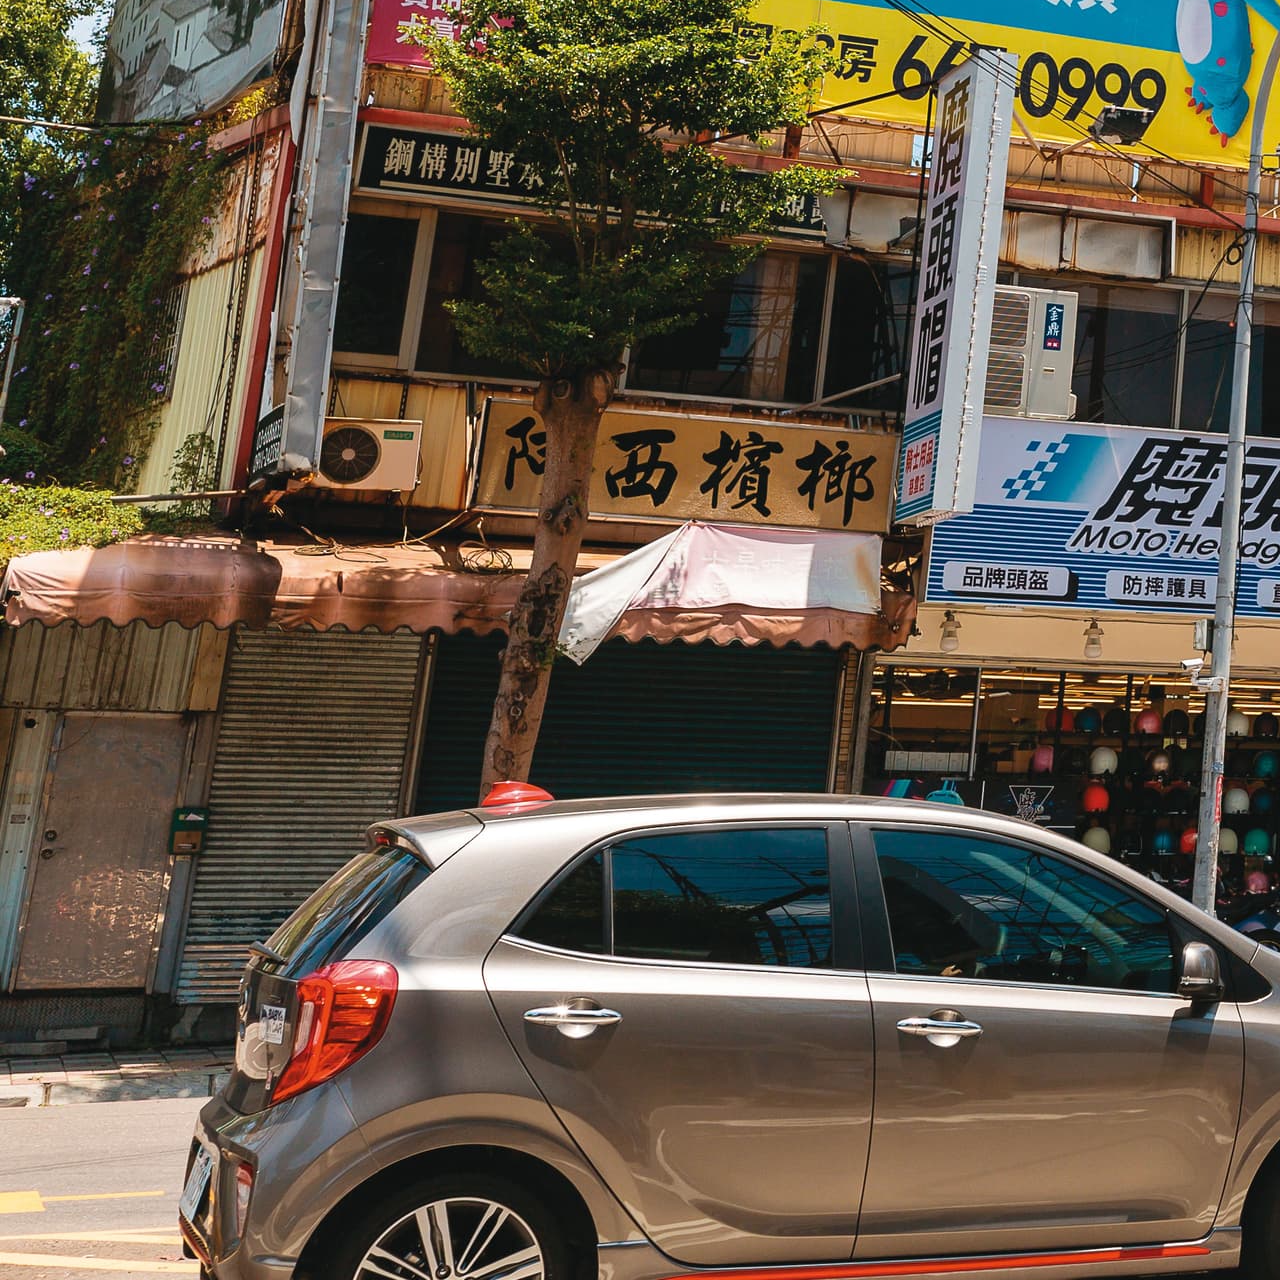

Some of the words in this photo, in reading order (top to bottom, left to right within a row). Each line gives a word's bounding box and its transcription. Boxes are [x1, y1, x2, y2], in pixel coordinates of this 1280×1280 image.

[912, 75, 971, 410] 魔頭帽
[962, 565, 1049, 592] 品牌頭盔
[1123, 575, 1207, 600] 防摔護具
